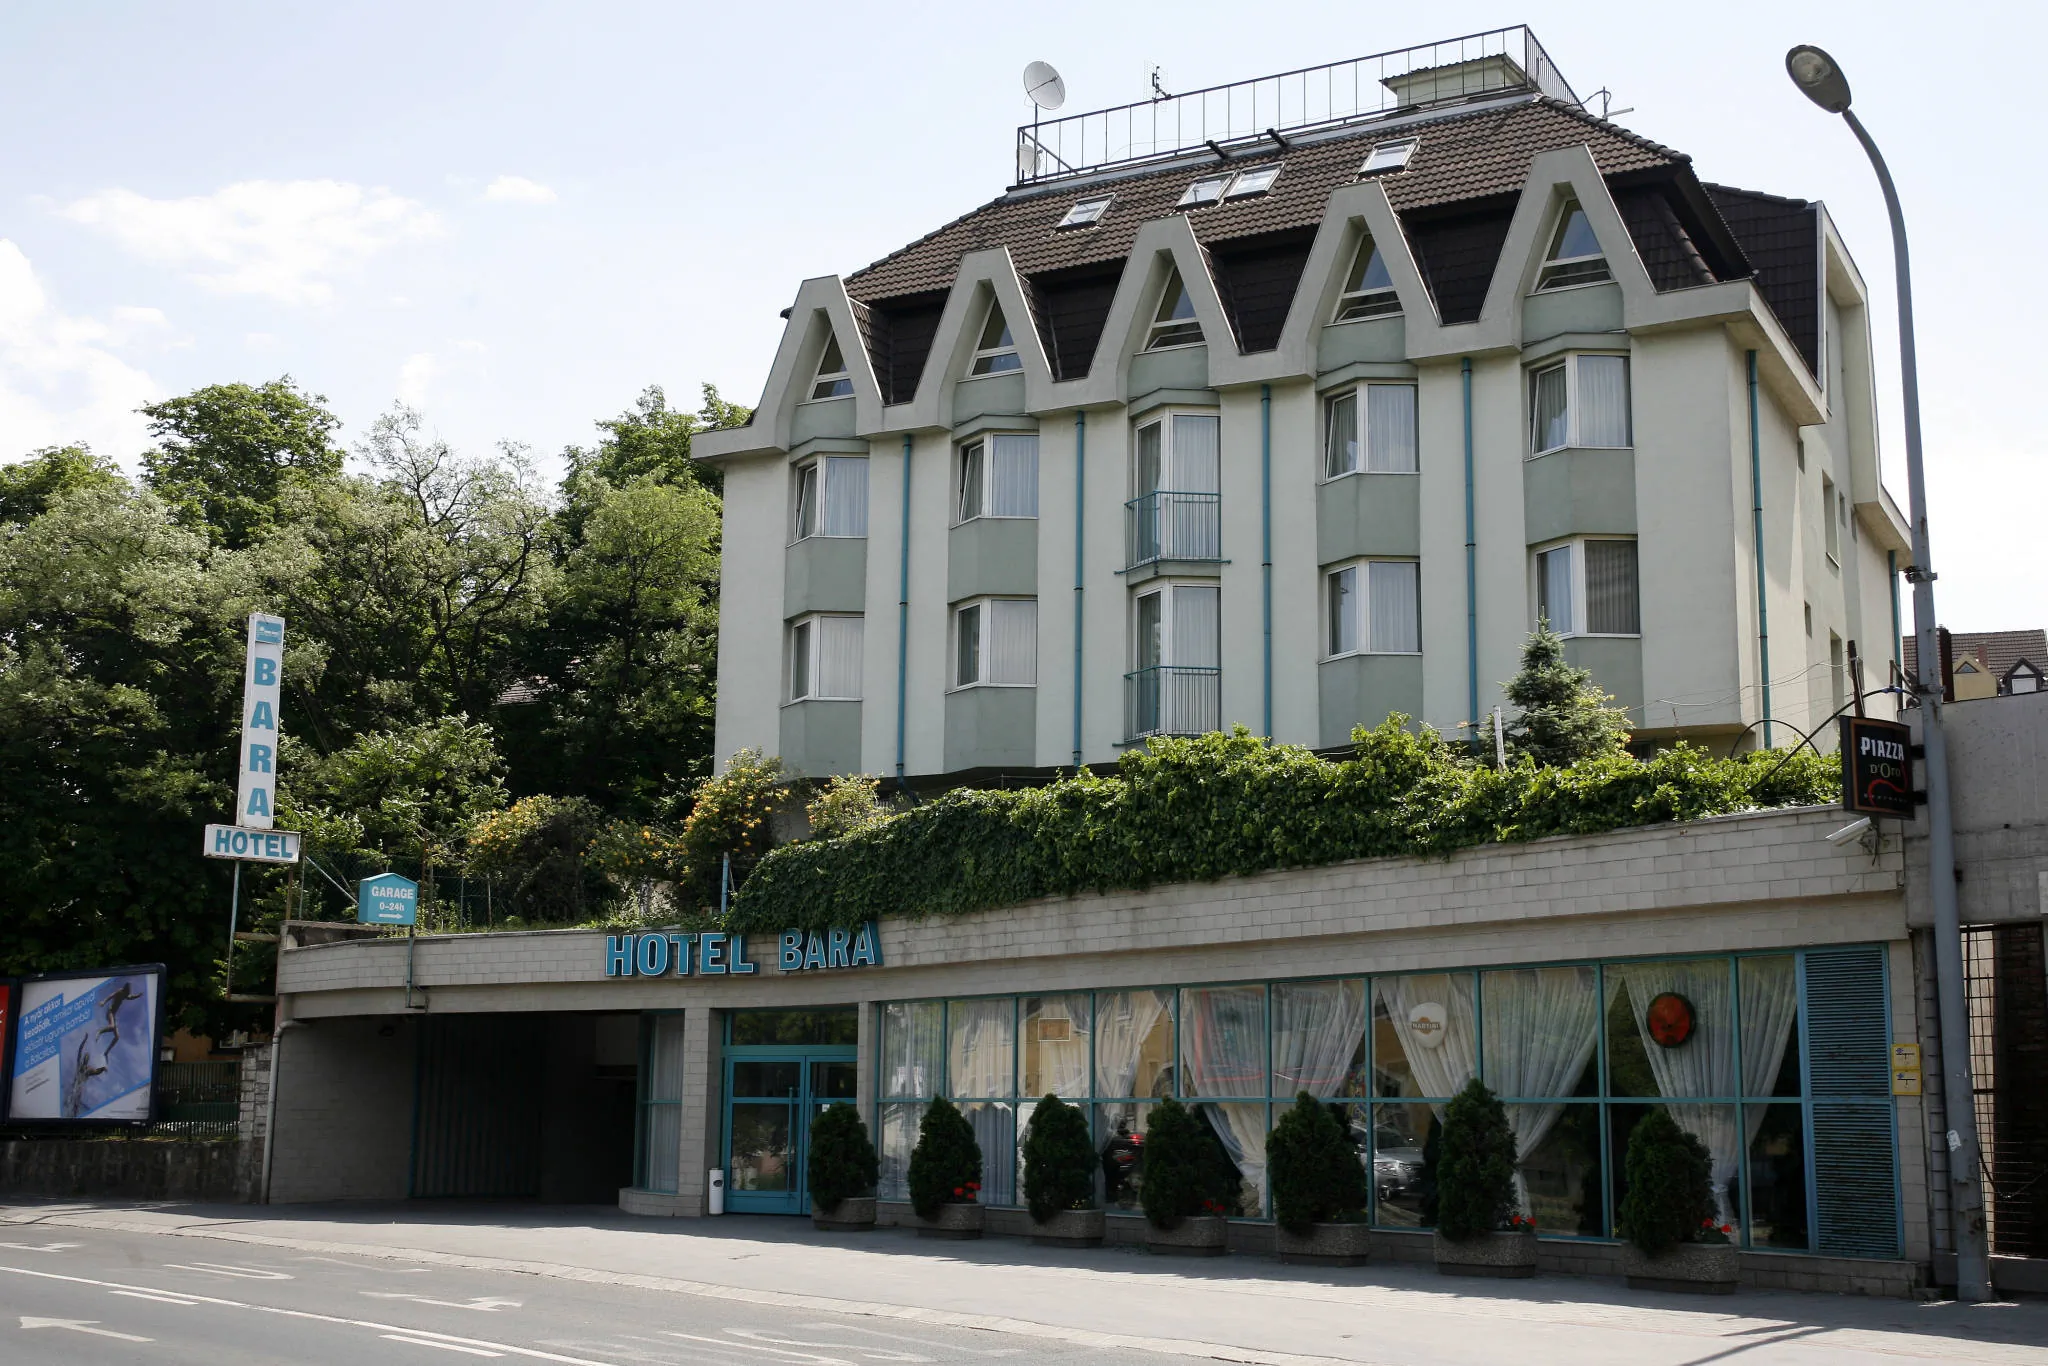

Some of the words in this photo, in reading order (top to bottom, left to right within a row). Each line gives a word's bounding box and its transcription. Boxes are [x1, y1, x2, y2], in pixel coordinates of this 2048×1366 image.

[246, 656, 277, 818] BARA
[1860, 736, 1905, 761] PIAZZA
[214, 829, 293, 859] HOTEL
[371, 886, 414, 900] GARAGE
[379, 902, 405, 912] 0-24h
[605, 932, 757, 976] HOTEL
[778, 920, 881, 972] BARA
[1412, 1022, 1440, 1030] MARTINI
